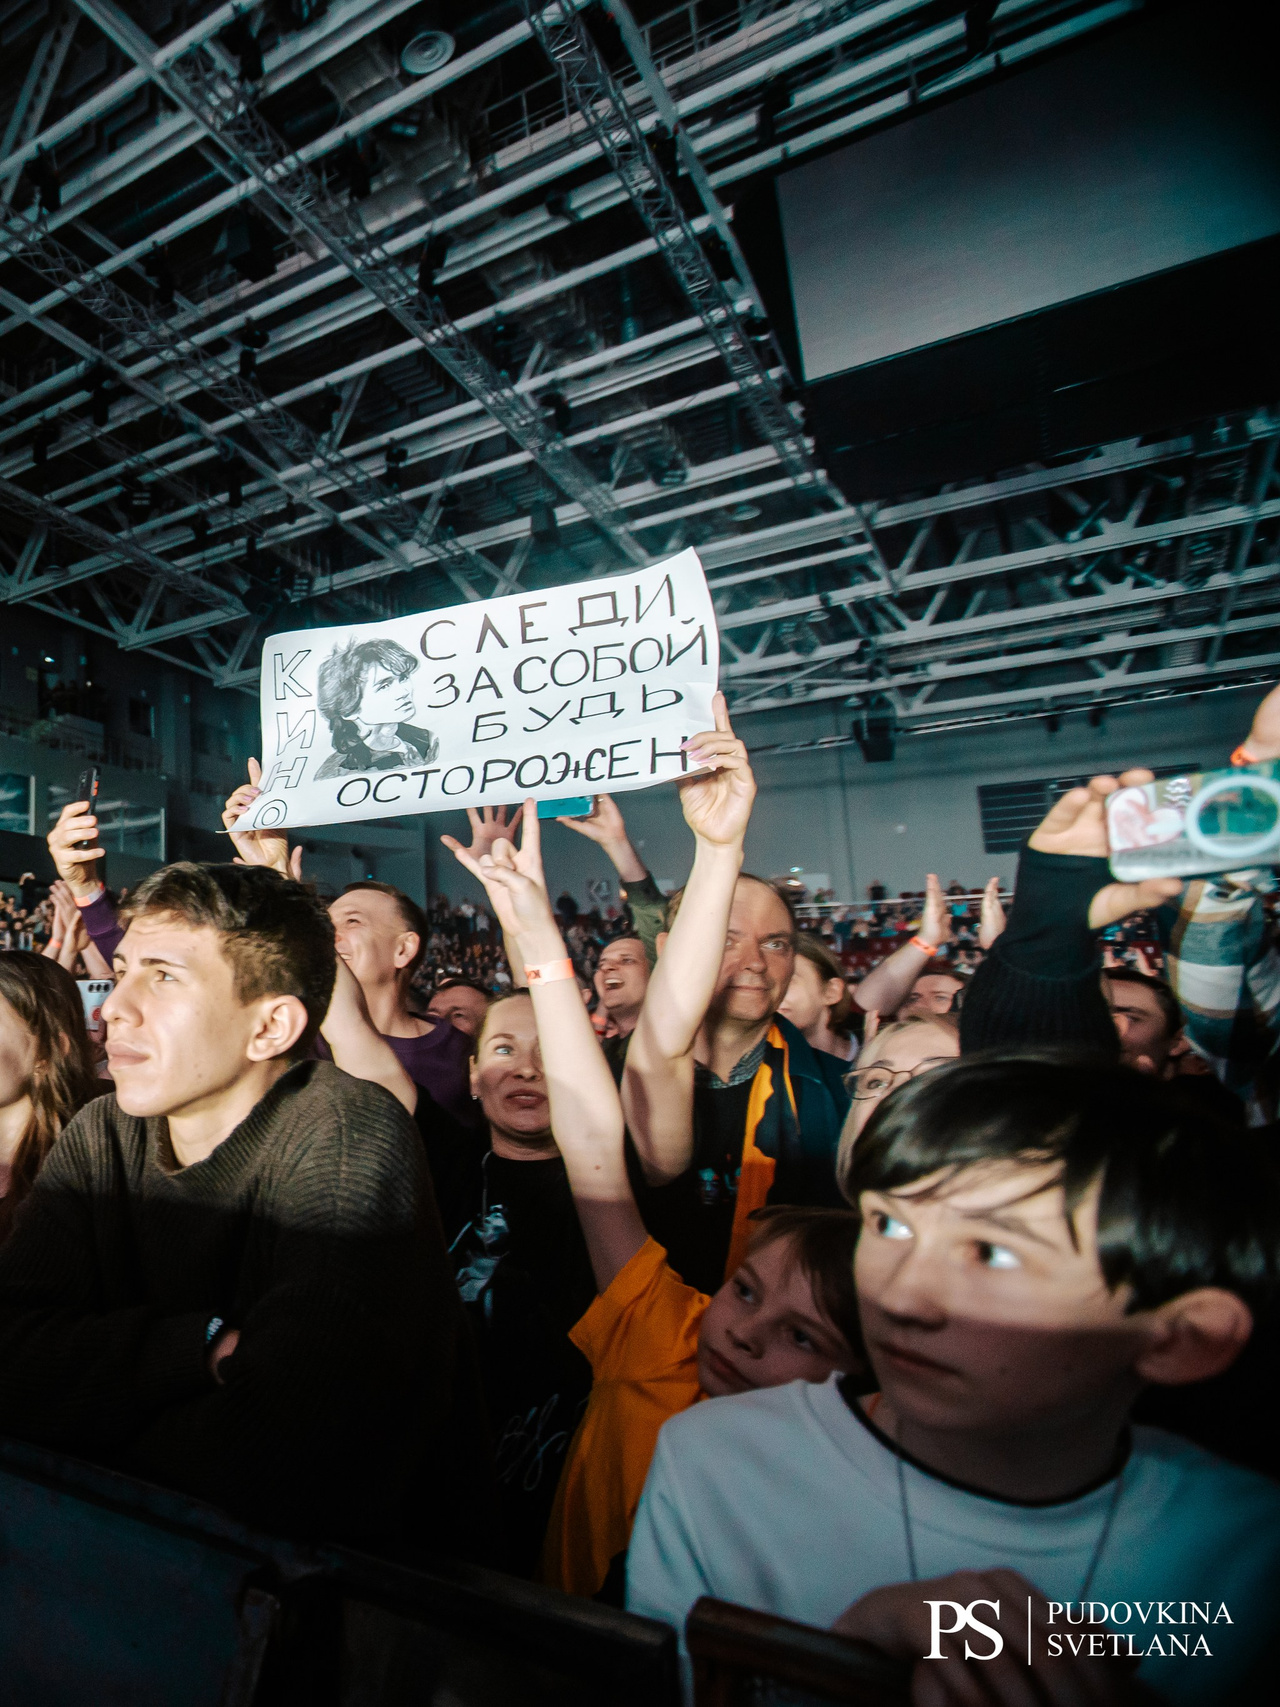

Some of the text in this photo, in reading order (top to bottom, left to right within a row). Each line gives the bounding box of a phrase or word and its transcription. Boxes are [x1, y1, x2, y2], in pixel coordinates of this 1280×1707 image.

[419, 573, 677, 661] СЛЕДИ
[253, 649, 316, 830] КИНО
[472, 684, 684, 743] БУДЬ
[337, 736, 689, 807] ОСТОРОЖЕН
